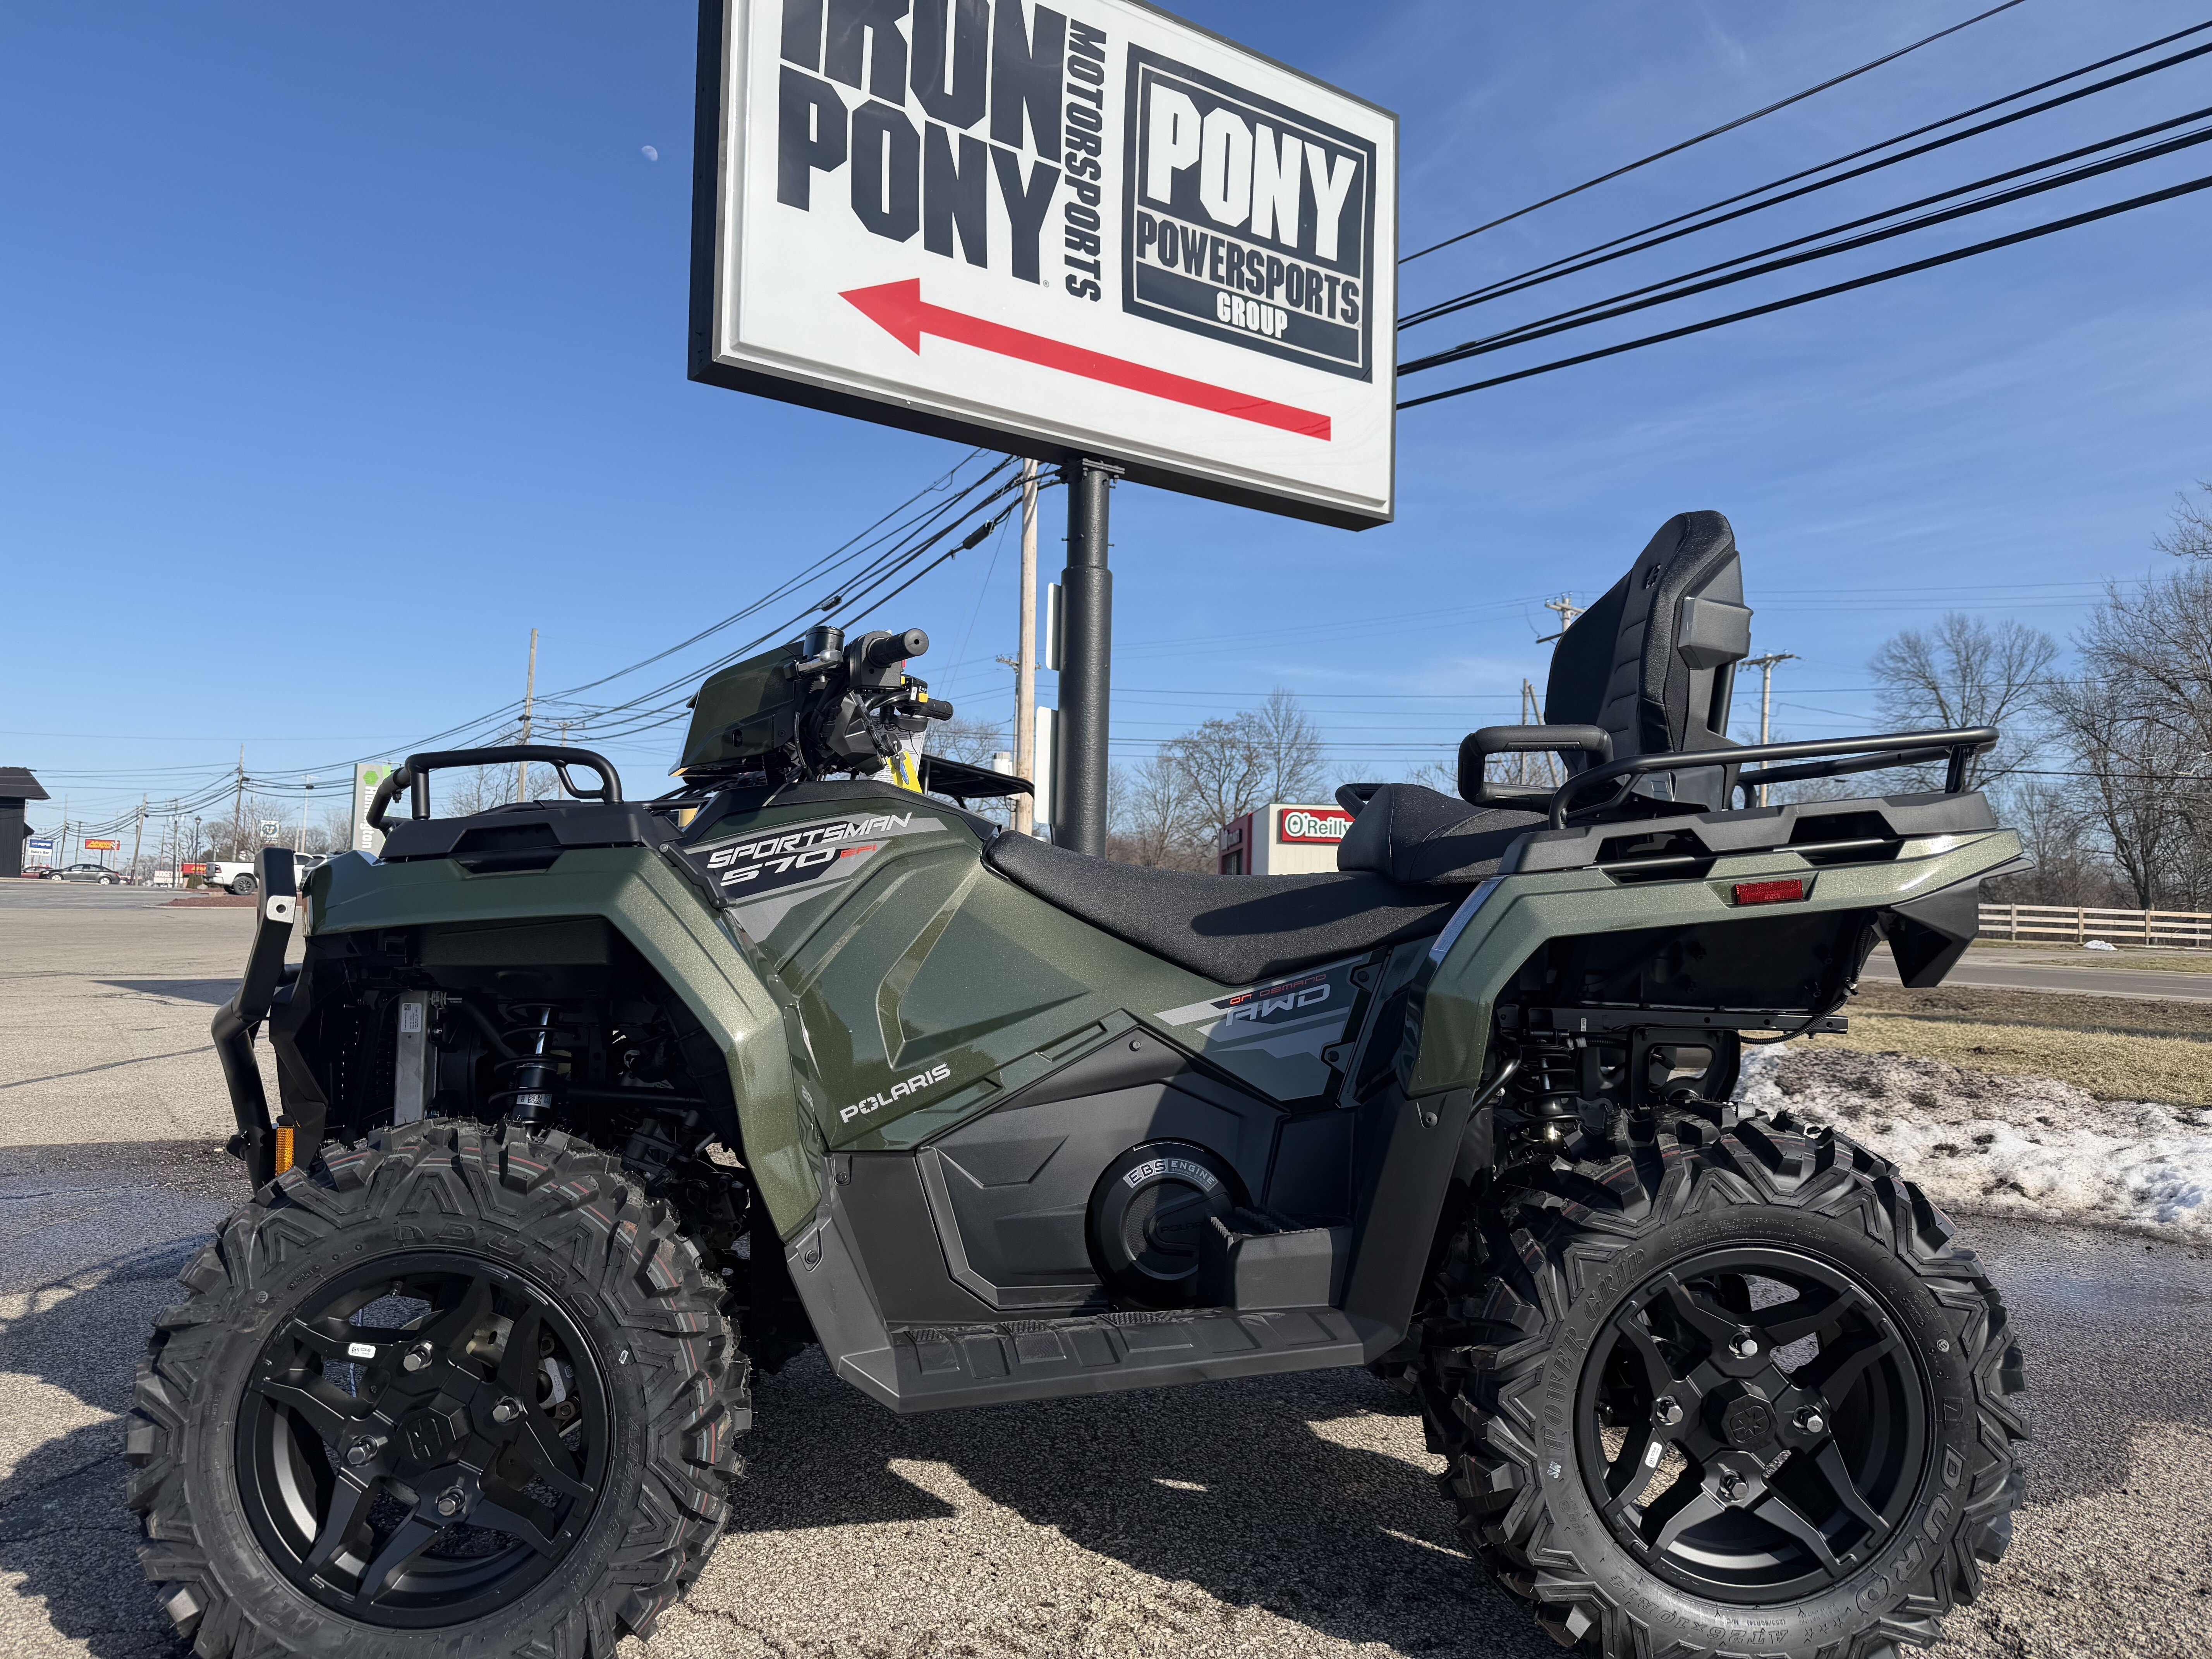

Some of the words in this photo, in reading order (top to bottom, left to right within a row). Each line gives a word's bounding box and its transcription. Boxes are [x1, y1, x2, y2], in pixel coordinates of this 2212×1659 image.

[777, 65, 1063, 285] PONY
[1064, 18, 1107, 303] MOTORSPORTS
[1146, 81, 1357, 262] PONY
[1136, 213, 1361, 325] POWERSPORTS
[1216, 291, 1289, 339] GROUP
[707, 812, 912, 868] SPORTSMAN
[720, 847, 836, 886] 570
[1225, 983, 1331, 1027] AWD
[1230, 993, 1252, 1005] ON
[1259, 974, 1326, 997] DEMAND
[840, 1063, 951, 1123] POLARIS
[1128, 1160, 1166, 1184] EBS
[1171, 1160, 1215, 1185] ENGINE
[1160, 1221, 1204, 1233] POLAR
[1584, 1249, 1645, 1321] GRIP
[1544, 1327, 1585, 1451] POWER
[1856, 1443, 1966, 1614] DURO
